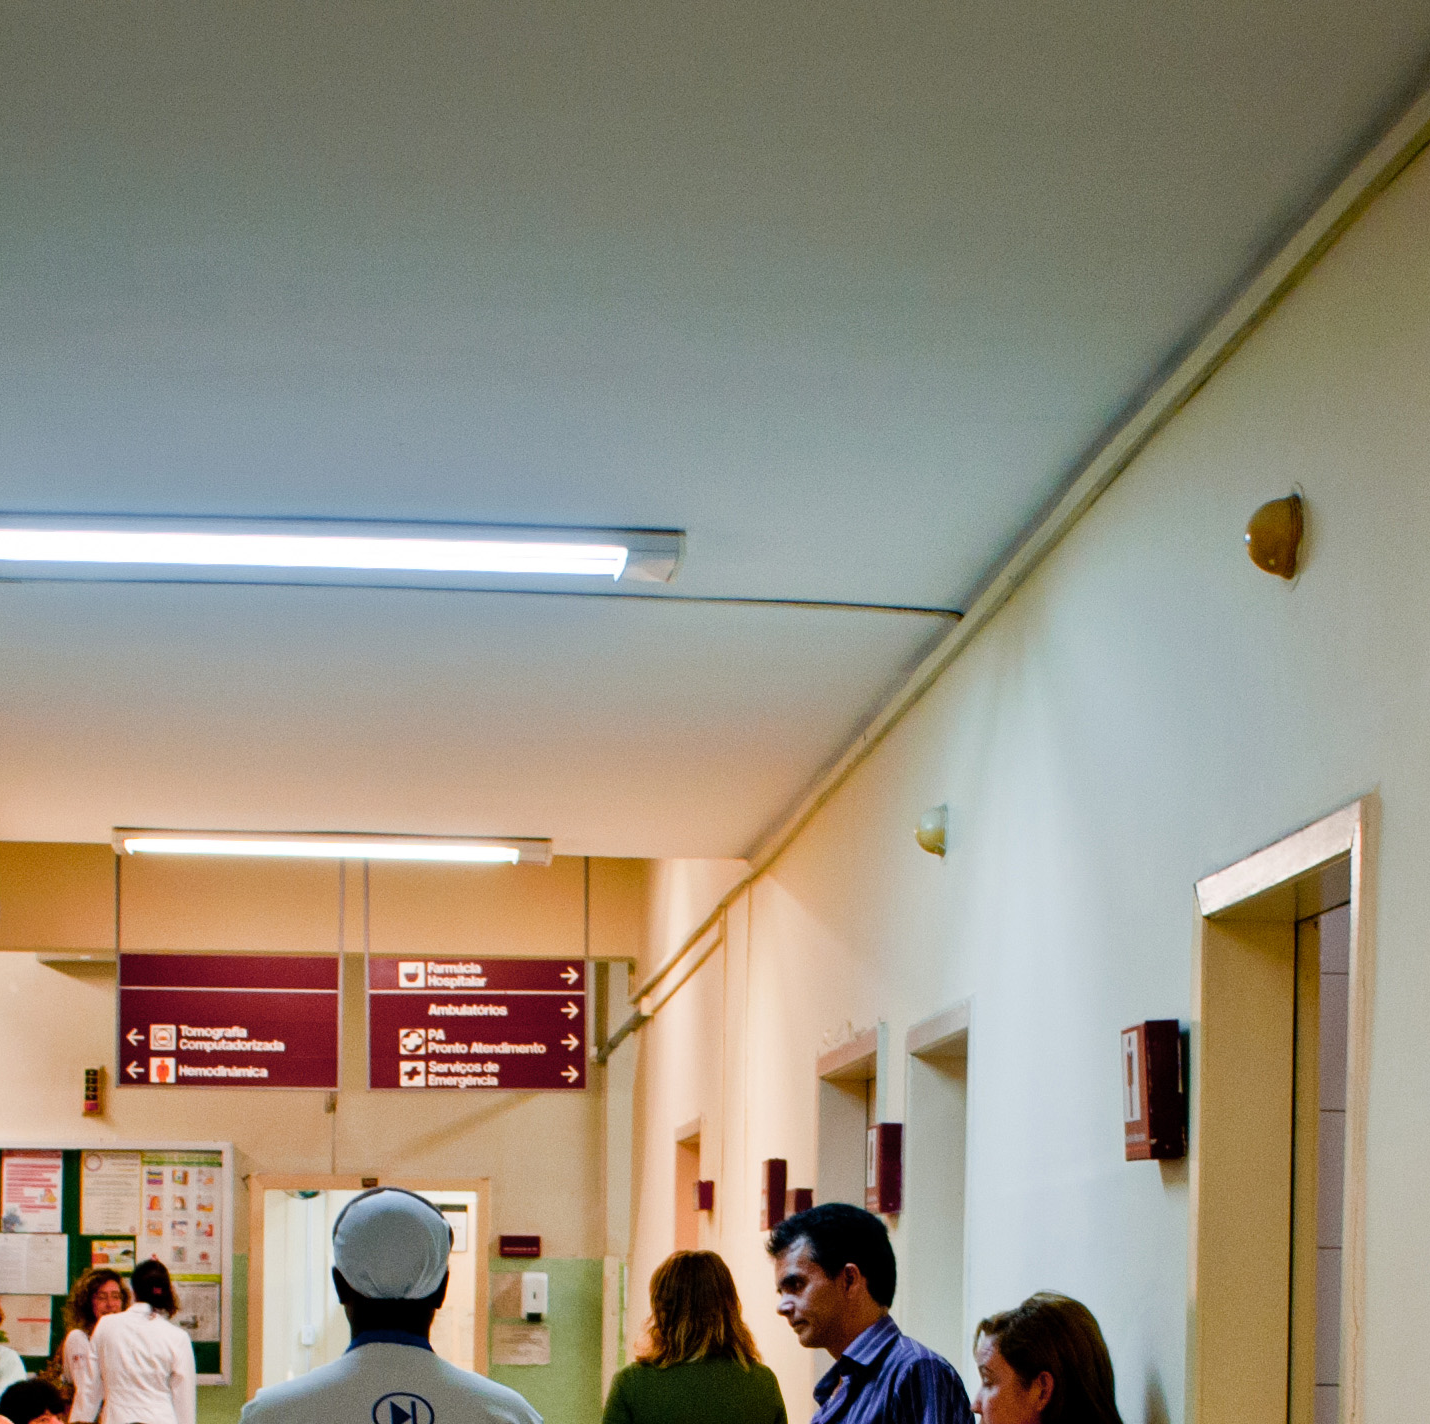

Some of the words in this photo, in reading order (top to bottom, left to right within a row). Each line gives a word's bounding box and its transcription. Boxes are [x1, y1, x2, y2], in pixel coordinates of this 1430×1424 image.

[427, 962, 482, 974] Farmácia
[427, 975, 487, 988] Hospitalar
[428, 1004, 508, 1016] Ambulatórios
[179, 1025, 248, 1040] Tomografia
[428, 1029, 446, 1041] PA
[179, 1039, 286, 1052] Computadorizada
[428, 1042, 469, 1054] Pronto
[470, 1042, 547, 1054] Atendimento
[428, 1061, 482, 1074] Serviços
[483, 1061, 500, 1073] de
[428, 1074, 499, 1088] Emergência
